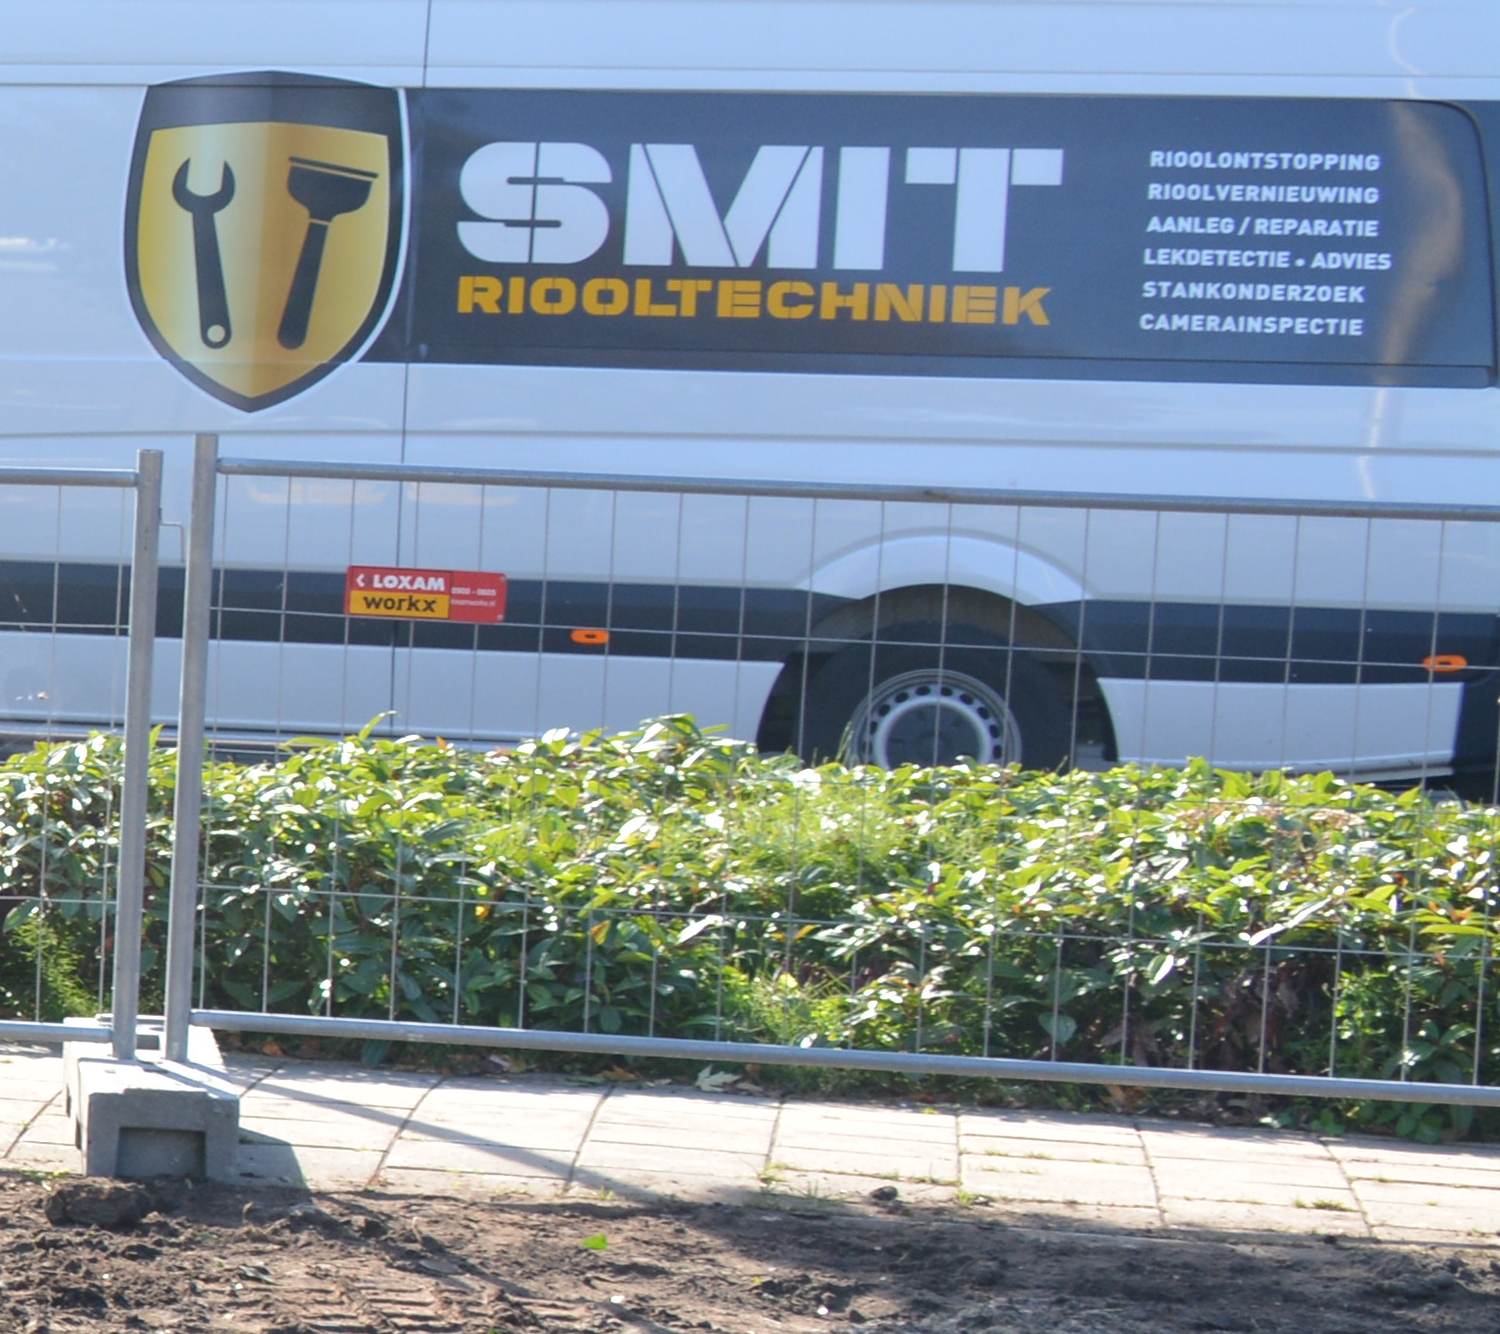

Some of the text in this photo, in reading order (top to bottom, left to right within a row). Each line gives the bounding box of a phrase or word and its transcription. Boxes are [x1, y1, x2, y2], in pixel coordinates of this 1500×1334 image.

[1149, 150, 1381, 172] RIOOLONTSTOPPING
[1147, 183, 1380, 204] RIOOLVERNIEUWING
[456, 141, 1064, 272] SMIT
[1146, 216, 1235, 235] AANLEG
[1253, 218, 1379, 237] REPARATIE
[1143, 248, 1392, 271] LEKDETECTIE ADVIES
[456, 275, 1052, 326] RIOOLTECHNIEK
[1141, 281, 1366, 303] STANKONDERZOEK
[1139, 313, 1364, 336] CAMERAINSPECTIE
[372, 573, 446, 592] LOXAM
[363, 595, 438, 613] workx
